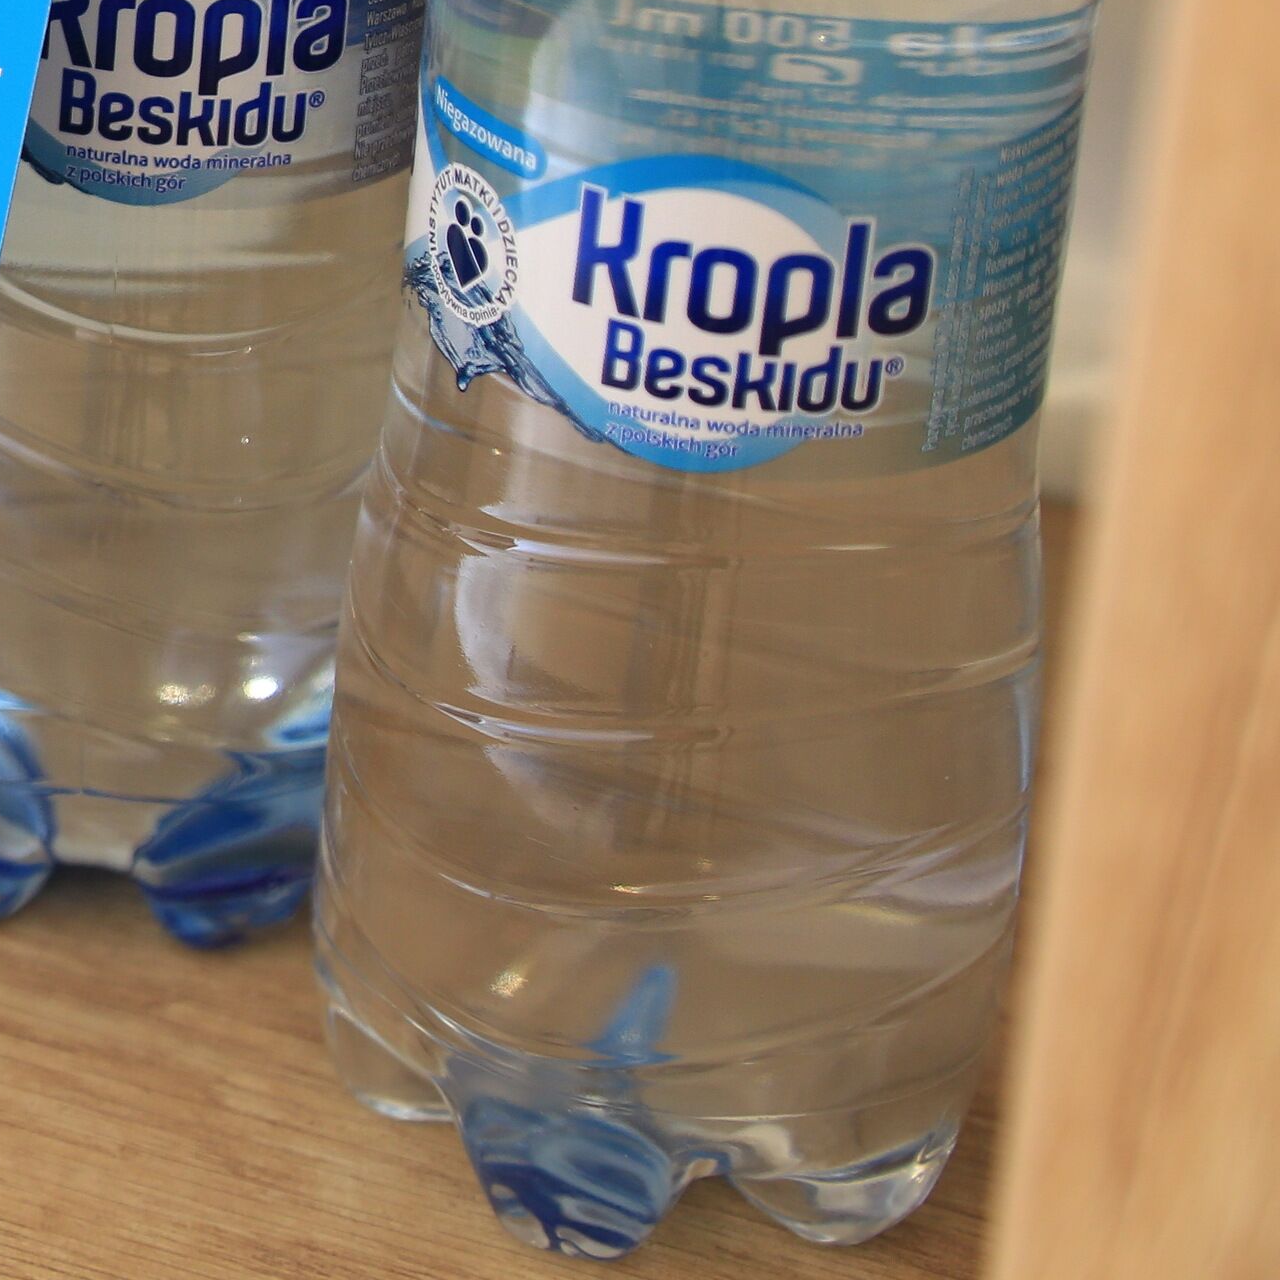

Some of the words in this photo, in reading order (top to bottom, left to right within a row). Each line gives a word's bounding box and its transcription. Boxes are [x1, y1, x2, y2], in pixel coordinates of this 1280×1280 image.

[435, 85, 538, 171] Niegazowana
[66, 143, 149, 168] naturalna
[153, 154, 201, 170] woda
[206, 152, 292, 171] mineralna
[66, 164, 77, 179] z
[79, 166, 152, 189] polskich
[155, 174, 187, 194] gór
[428, 170, 452, 253] INSTYTUT
[454, 167, 496, 209] MATKI
[495, 219, 519, 308] DZIECKA
[572, 187, 936, 356] Kropla
[605, 423, 618, 436] z
[620, 424, 702, 454] polskich
[607, 400, 701, 430] naturalna
[706, 419, 761, 438] woda
[765, 421, 865, 439] mineralna
